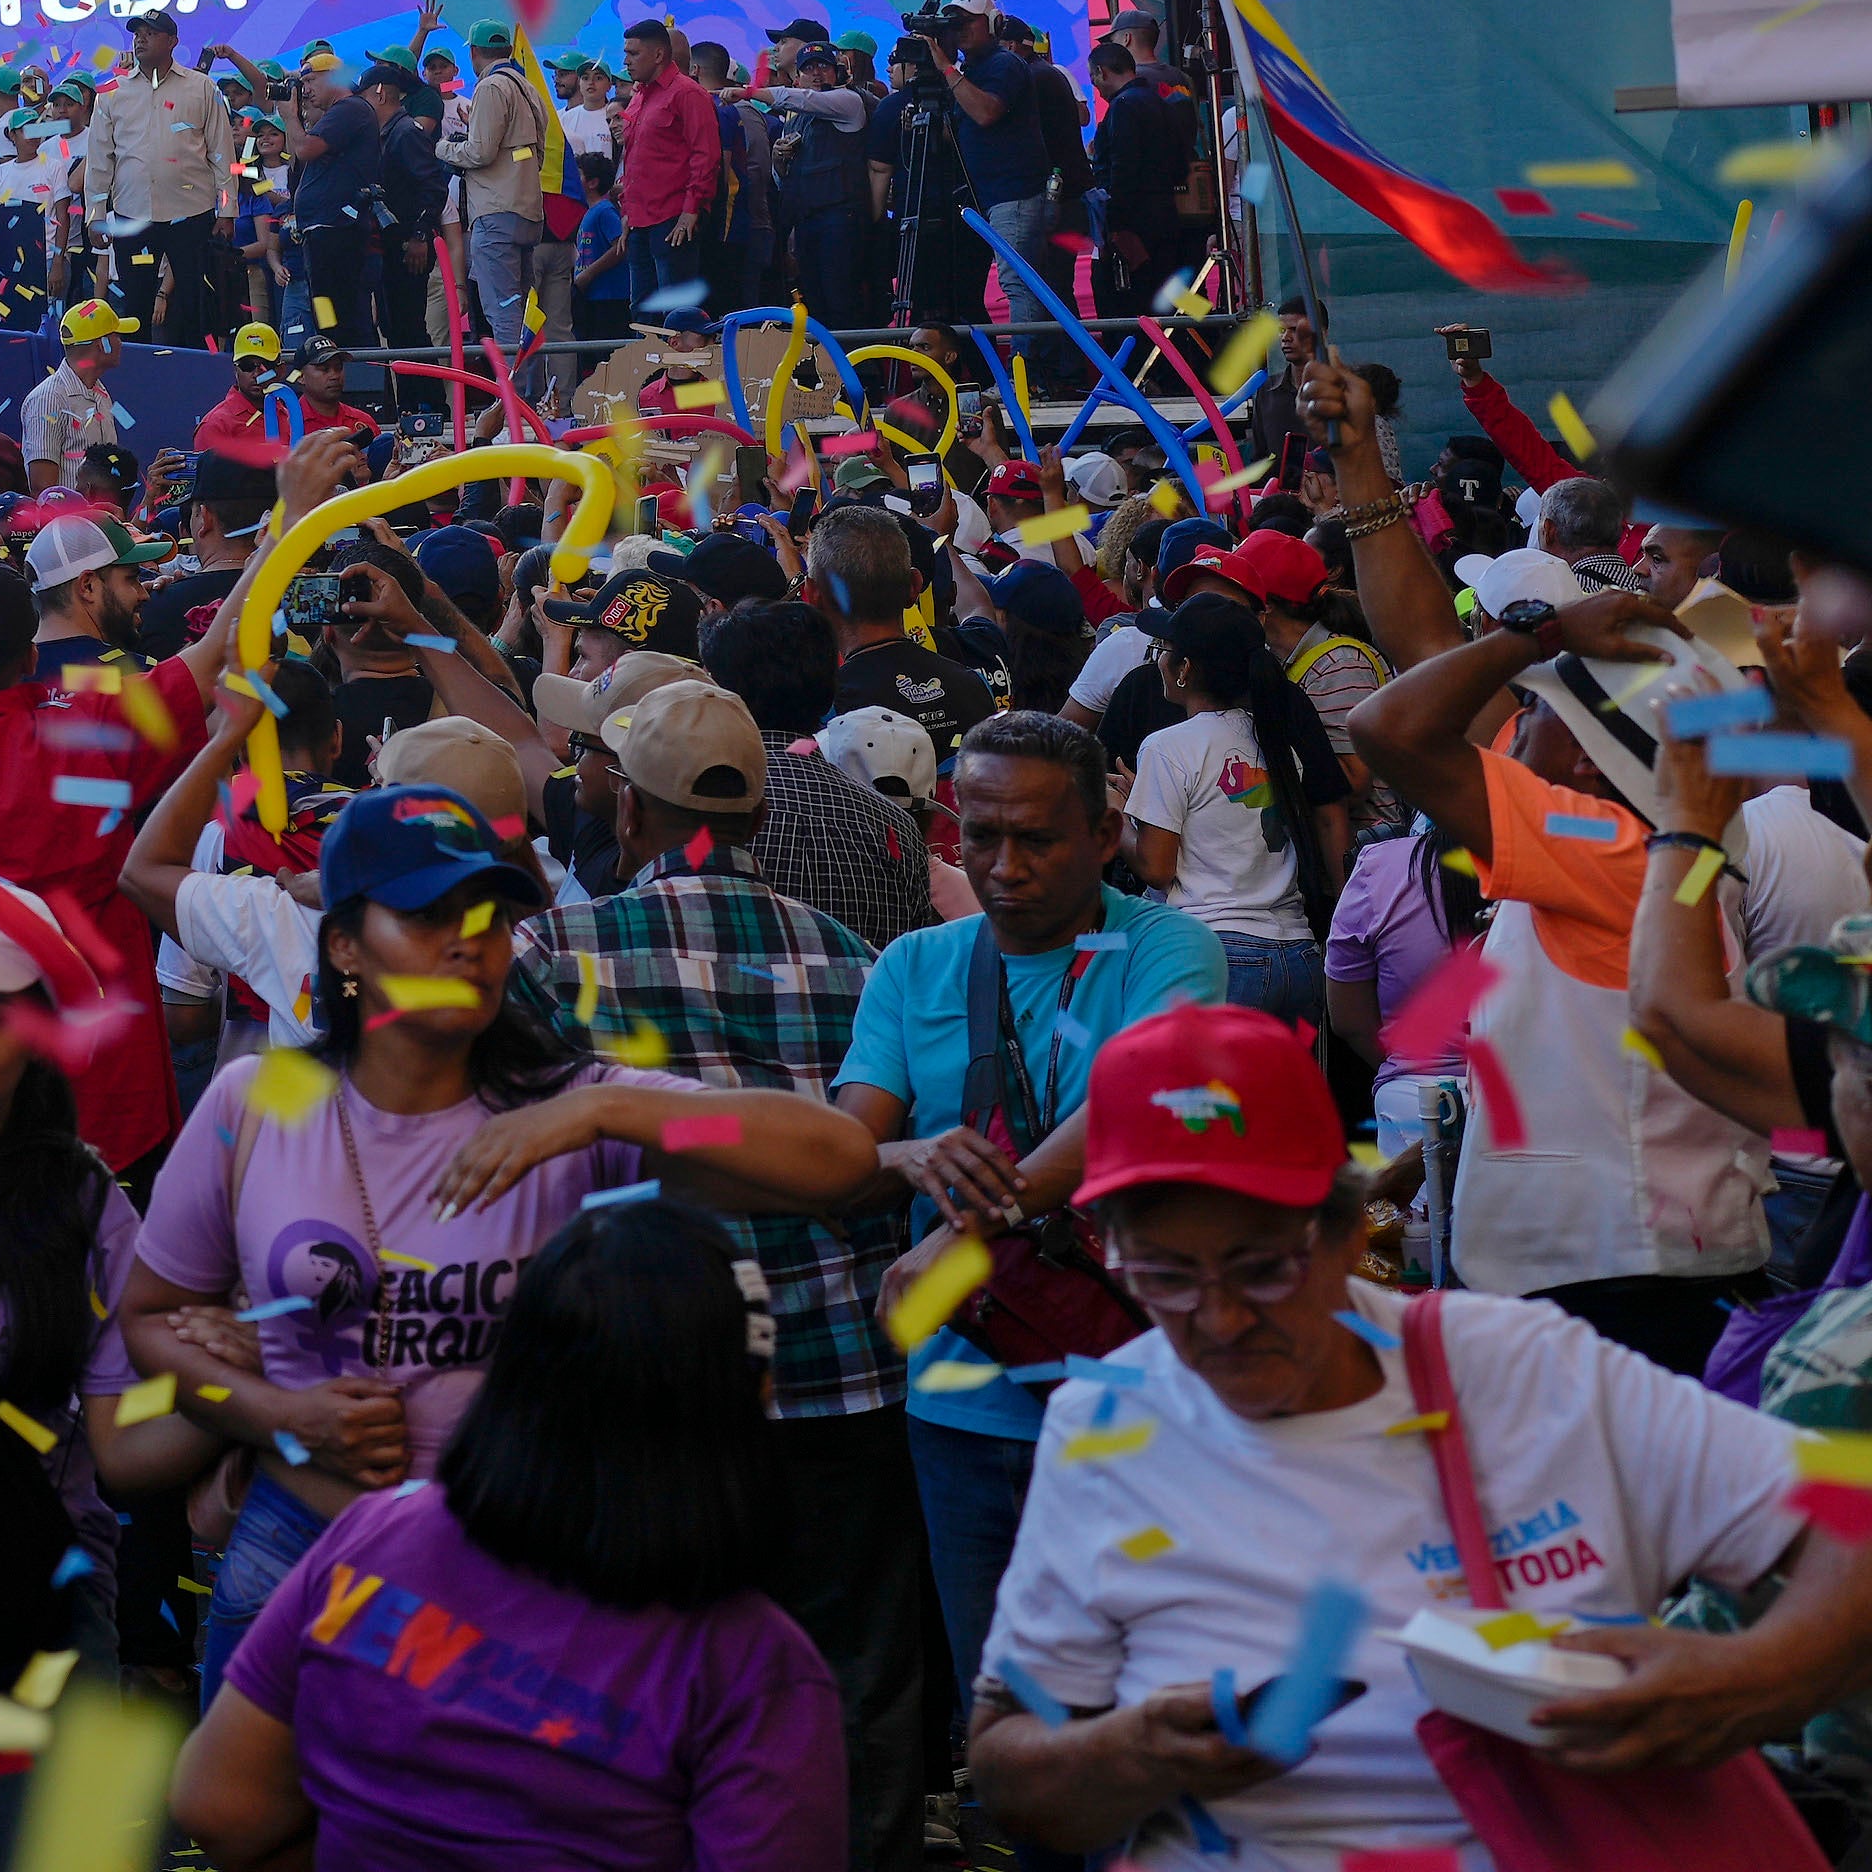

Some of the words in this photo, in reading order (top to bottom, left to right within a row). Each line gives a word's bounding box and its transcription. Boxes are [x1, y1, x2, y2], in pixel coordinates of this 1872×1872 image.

[1459, 479, 1479, 501] T
[901, 685, 925, 698] Vida
[362, 1317, 504, 1369] URQU
[1495, 1537, 1605, 1592] TODA
